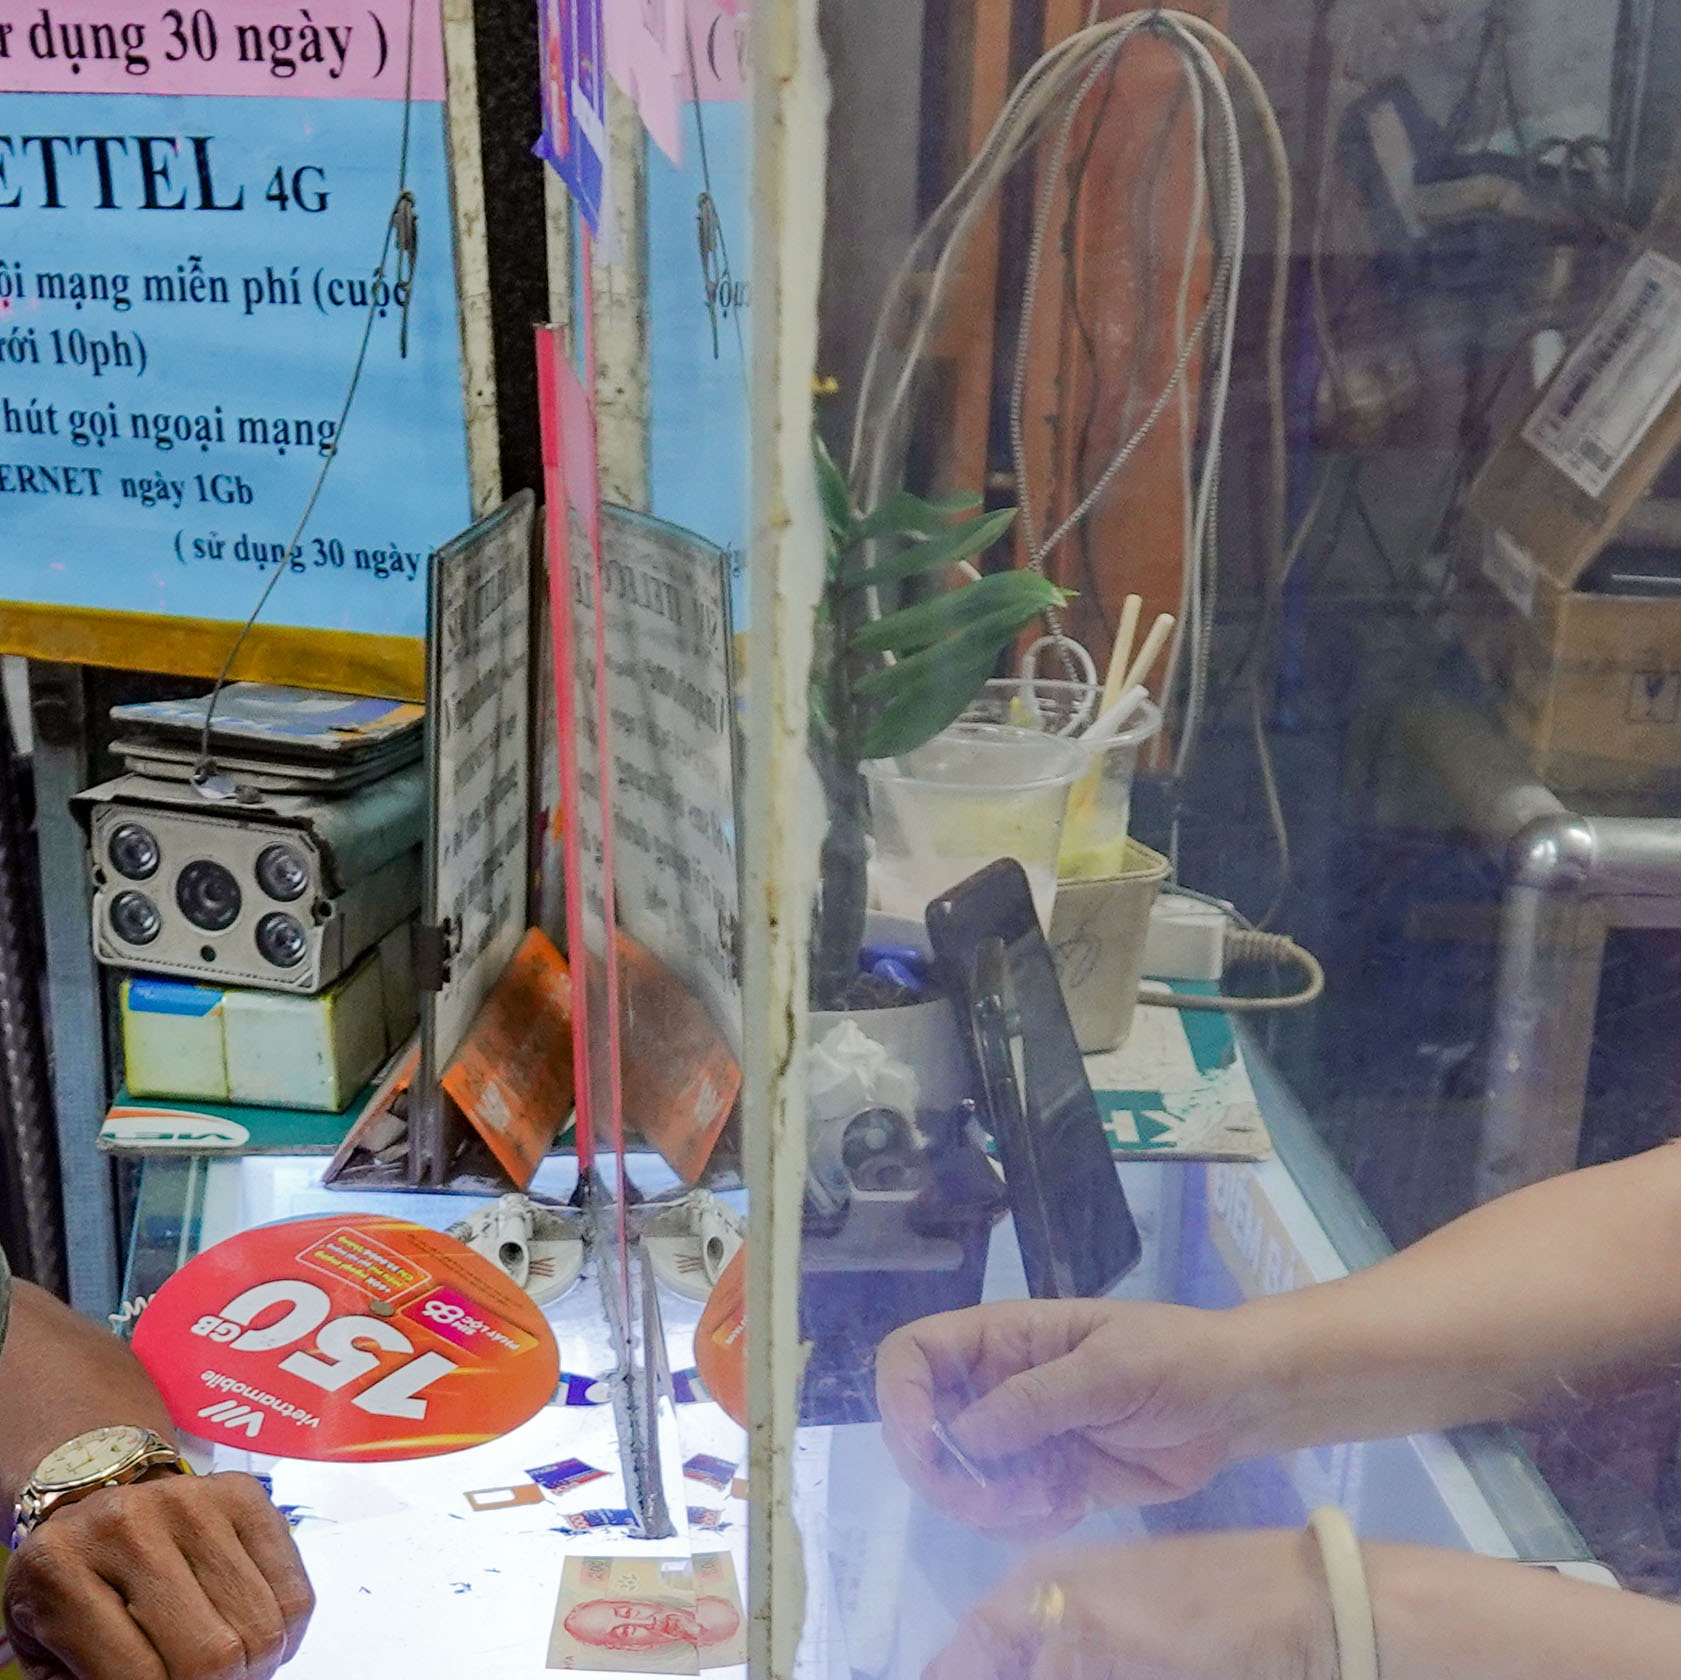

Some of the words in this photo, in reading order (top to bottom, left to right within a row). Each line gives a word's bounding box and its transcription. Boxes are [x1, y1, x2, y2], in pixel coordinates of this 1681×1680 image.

[29, 11, 150, 74] dụng
[164, 11, 218, 62] 30
[238, 10, 354, 78] ngày
[265, 165, 331, 212] 4G
[36, 280, 129, 311] mạng
[144, 256, 229, 304] miễn
[242, 266, 302, 314] phí
[52, 330, 148, 376] 10ph)
[69, 402, 120, 446] gọi
[131, 408, 224, 454] ngoại
[238, 415, 338, 456] mạng
[121, 472, 198, 509] ngày
[194, 475, 253, 505] 1Gb
[235, 535, 305, 572] dụng
[312, 538, 345, 568] 30
[355, 542, 420, 579] ngày
[221, 1279, 458, 1420] 150
[200, 1370, 321, 1429] vietnamobile
